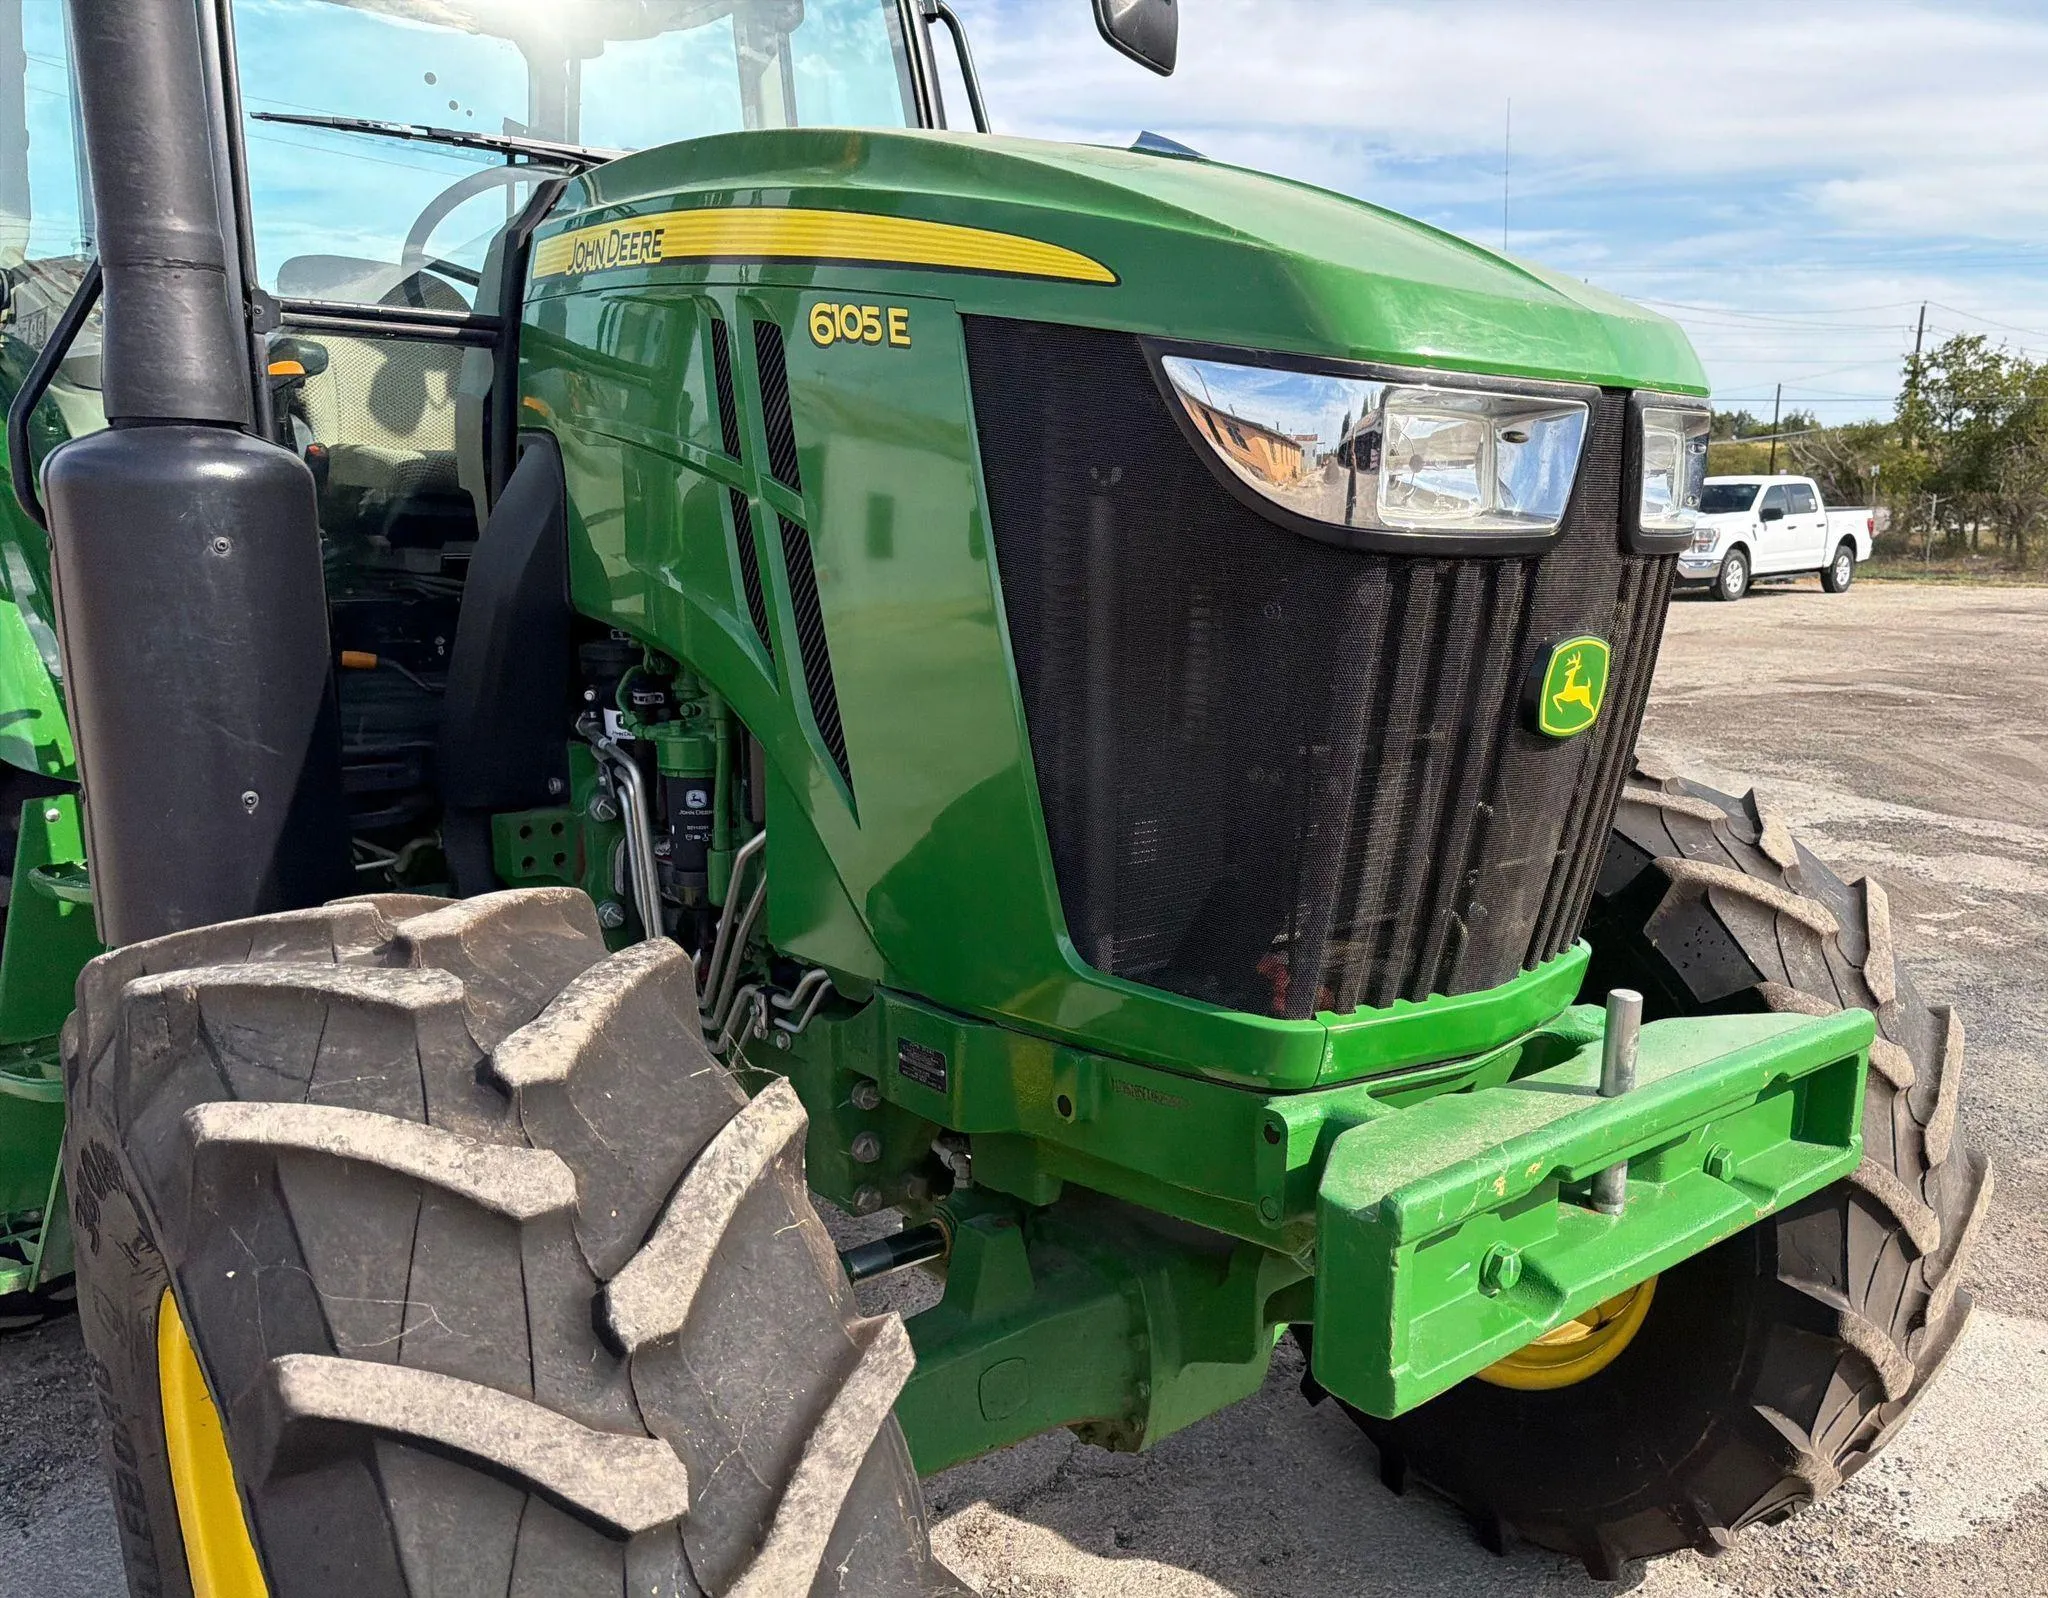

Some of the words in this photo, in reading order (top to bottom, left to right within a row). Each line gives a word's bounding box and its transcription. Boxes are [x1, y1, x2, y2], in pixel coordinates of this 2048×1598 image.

[566, 237, 607, 273] JOHN
[606, 228, 665, 265] DEERE
[809, 302, 883, 348] 6105
[886, 306, 912, 349] E
